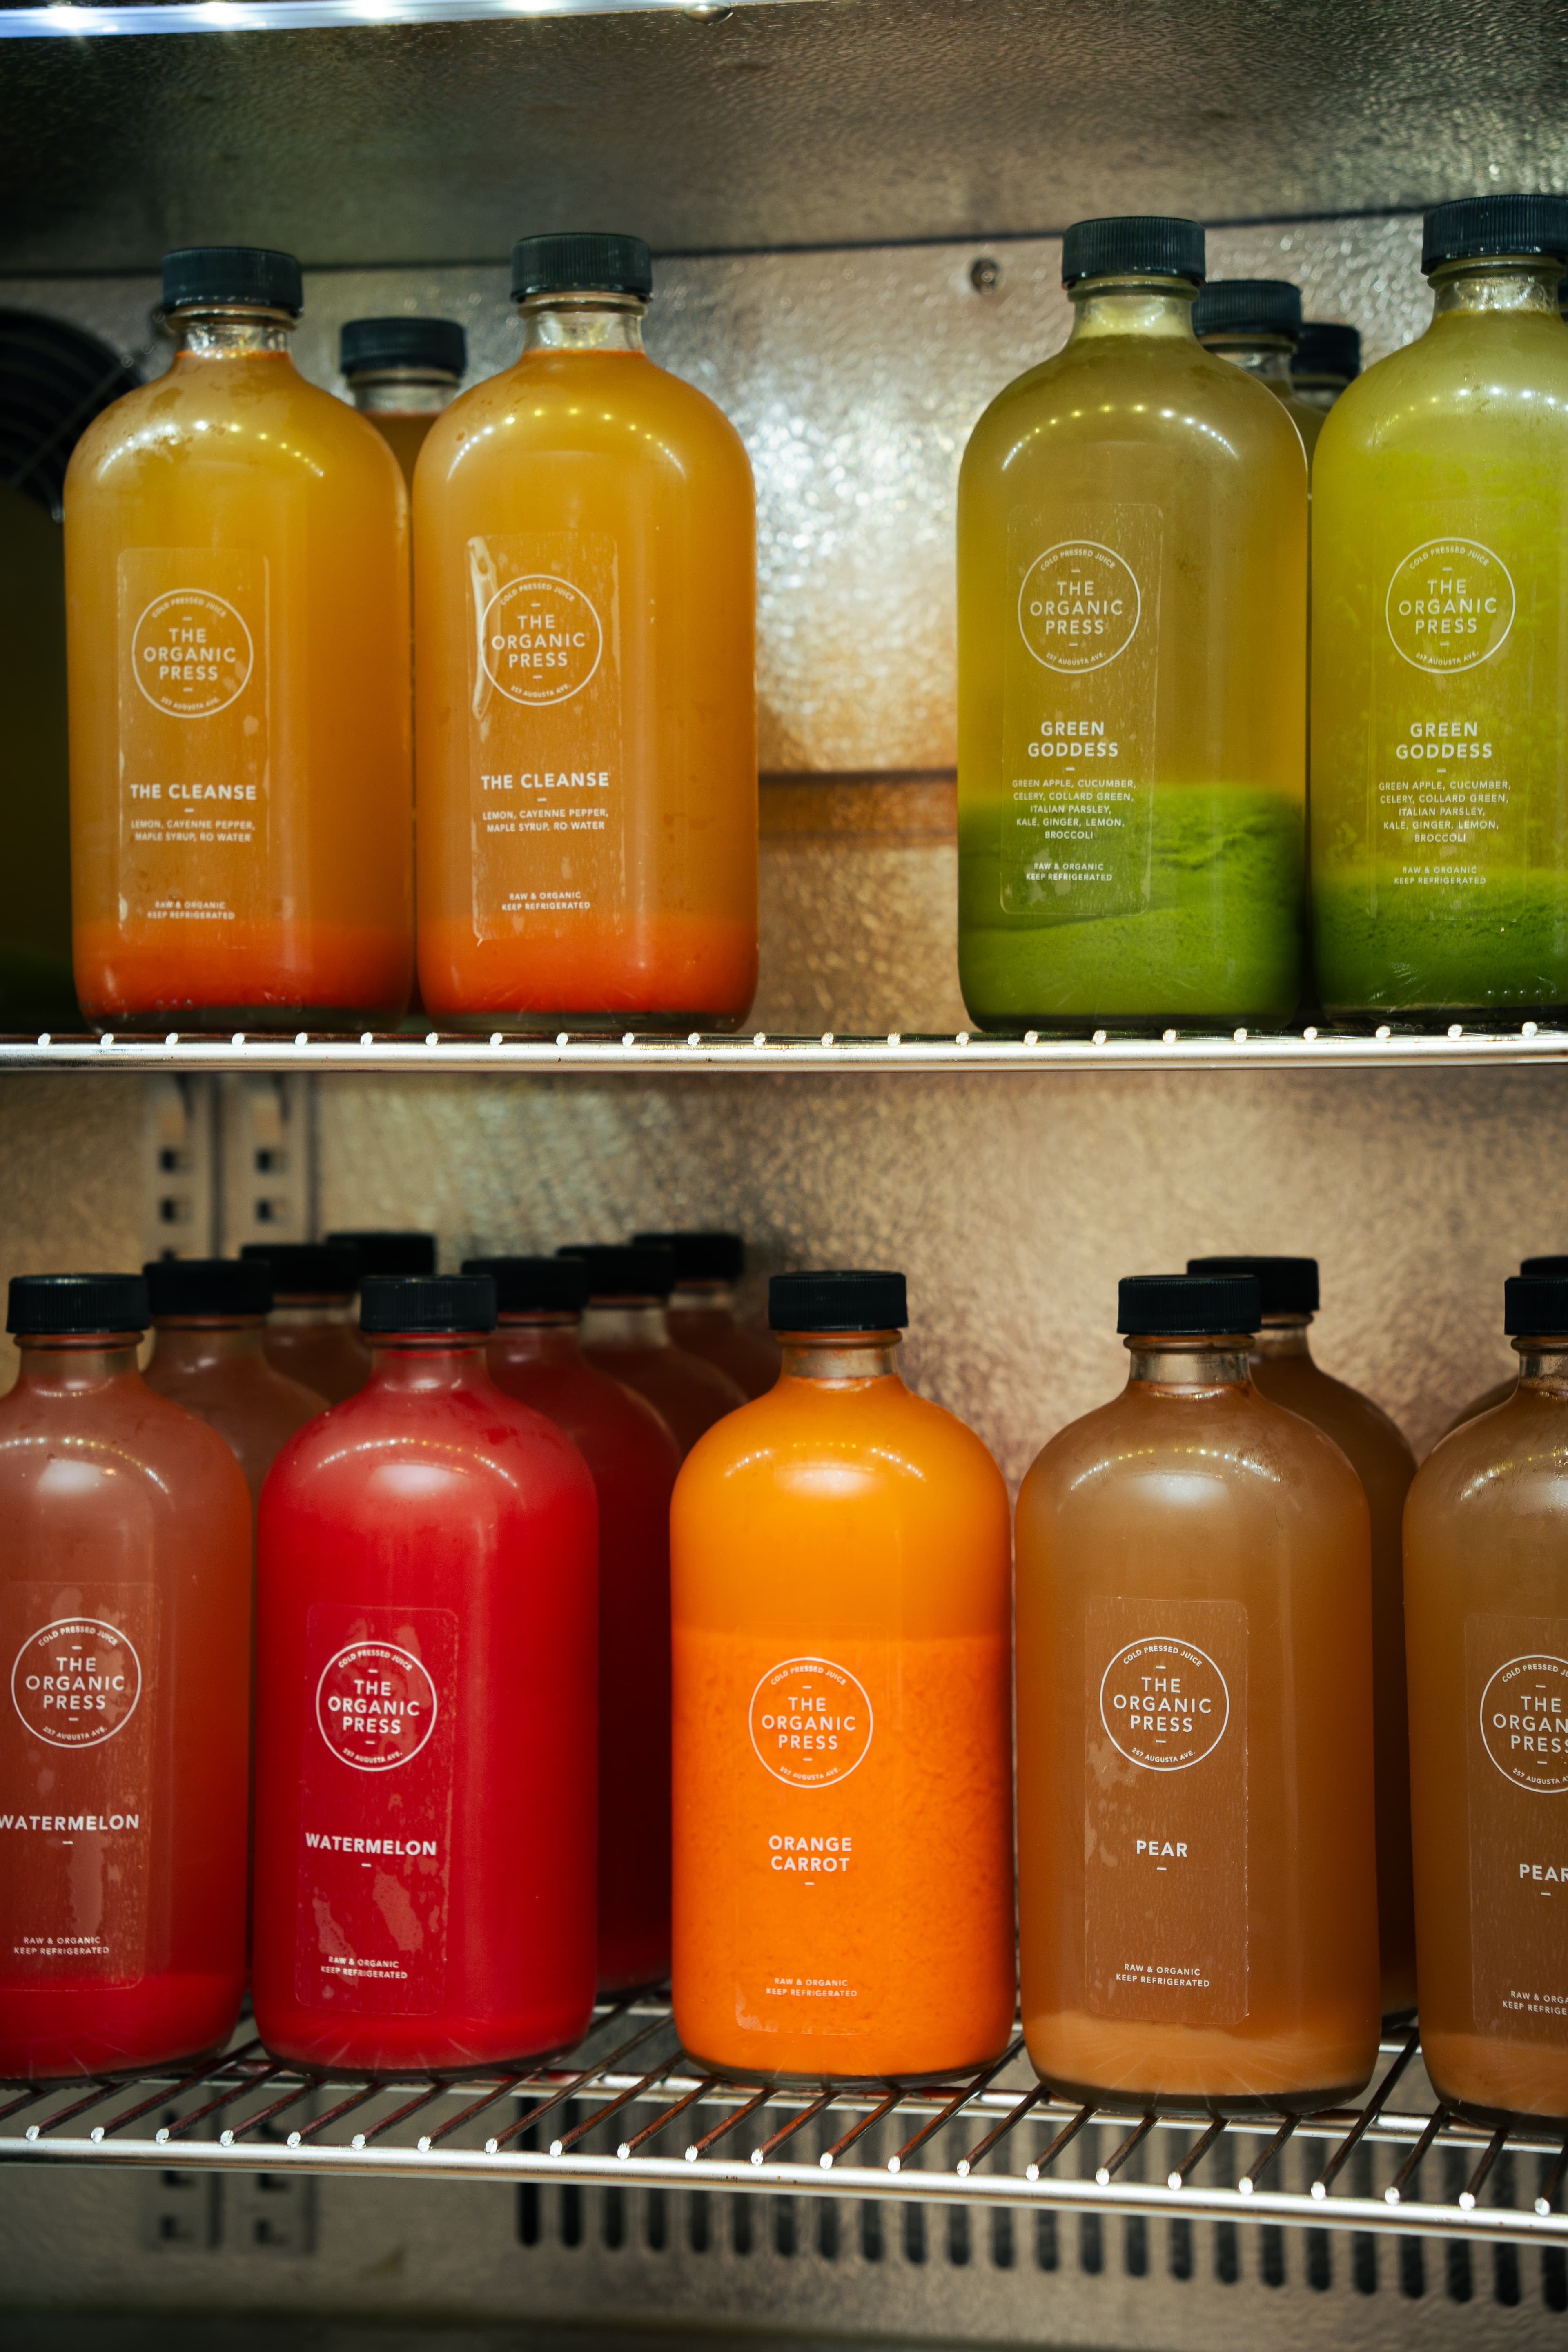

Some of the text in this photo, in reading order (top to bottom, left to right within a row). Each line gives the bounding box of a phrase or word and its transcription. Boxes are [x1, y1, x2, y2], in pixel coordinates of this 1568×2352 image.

[1041, 548, 1116, 571] COLD PRESSED JUICE
[1410, 546, 1490, 570] COLD PRESSED JUICE
[1057, 581, 1094, 596] THE
[1428, 579, 1466, 595] THE
[1030, 600, 1122, 616] ORGANIC
[1399, 597, 1497, 616] ORGANIC
[517, 614, 555, 630] THE
[1046, 620, 1104, 635] PRESS
[1415, 617, 1477, 634] PRESS
[169, 628, 206, 643] THE
[492, 632, 585, 650] ORGANIC
[143, 646, 236, 662] ORGANIC
[509, 652, 567, 668] PRESS
[160, 666, 218, 681] PRESS
[1041, 721, 1105, 736] GREEN
[1411, 721, 1477, 737] GREEN
[1028, 742, 1118, 757] GODDESS
[1396, 743, 1492, 760] GODDESS
[481, 772, 608, 790] THE CLEANSE
[1012, 780, 1039, 788] GREEN
[1379, 782, 1408, 791] GREEN
[130, 784, 256, 800] THE CLEANSE
[1049, 792, 1093, 801] COLLARD
[1419, 794, 1465, 803] COLLARD
[1030, 805, 1065, 814] ITALIAN
[1399, 807, 1435, 816] ITALIAN
[1045, 831, 1093, 840] BROCCOLI
[1415, 833, 1466, 842] BROCCOLI
[1048, 873, 1112, 881] REFRIGERATED
[1434, 865, 1477, 874] ORGANIC
[1123, 1645, 1203, 1667] COLD PRESSED JUICE
[56, 1657, 96, 1672] THE
[771, 1665, 846, 1686] COLD PRESSED JUICE
[1502, 1664, 1559, 1682] COLD PRESSED
[26, 1675, 125, 1690] ORGANIC
[354, 1679, 391, 1696] THE
[1141, 1677, 1180, 1693] THE
[43, 1695, 105, 1710] PRESS
[328, 1696, 420, 1716] ORGANIC
[788, 1697, 826, 1711] THE
[1114, 1695, 1212, 1713] ORGANIC
[1520, 1696, 1561, 1713] THE
[343, 1717, 401, 1734] PRESS
[762, 1715, 856, 1731] ORGANIC
[1131, 1715, 1192, 1733] PRESS
[1493, 1713, 1568, 1733] ORGAN
[778, 1735, 837, 1750] PRESS
[1131, 1748, 1196, 1763] 257 AUGUSTA AVE.
[1513, 1768, 1525, 1778] 257
[1526, 1775, 1560, 1785] AUGUSTA
[0, 1814, 139, 1830] WATERMELON
[305, 1833, 436, 1855] WATERMELON
[768, 1835, 852, 1851] ORANGE
[1136, 1840, 1187, 1857] PEAR
[771, 1856, 850, 1872] CARROT
[1156, 1967, 1200, 1976] ORGANIC
[1140, 1976, 1210, 1987] REFRIGERATED
[1511, 1991, 1530, 2000] RAW
[1503, 2000, 1568, 2015] KEEP REFRIGE
